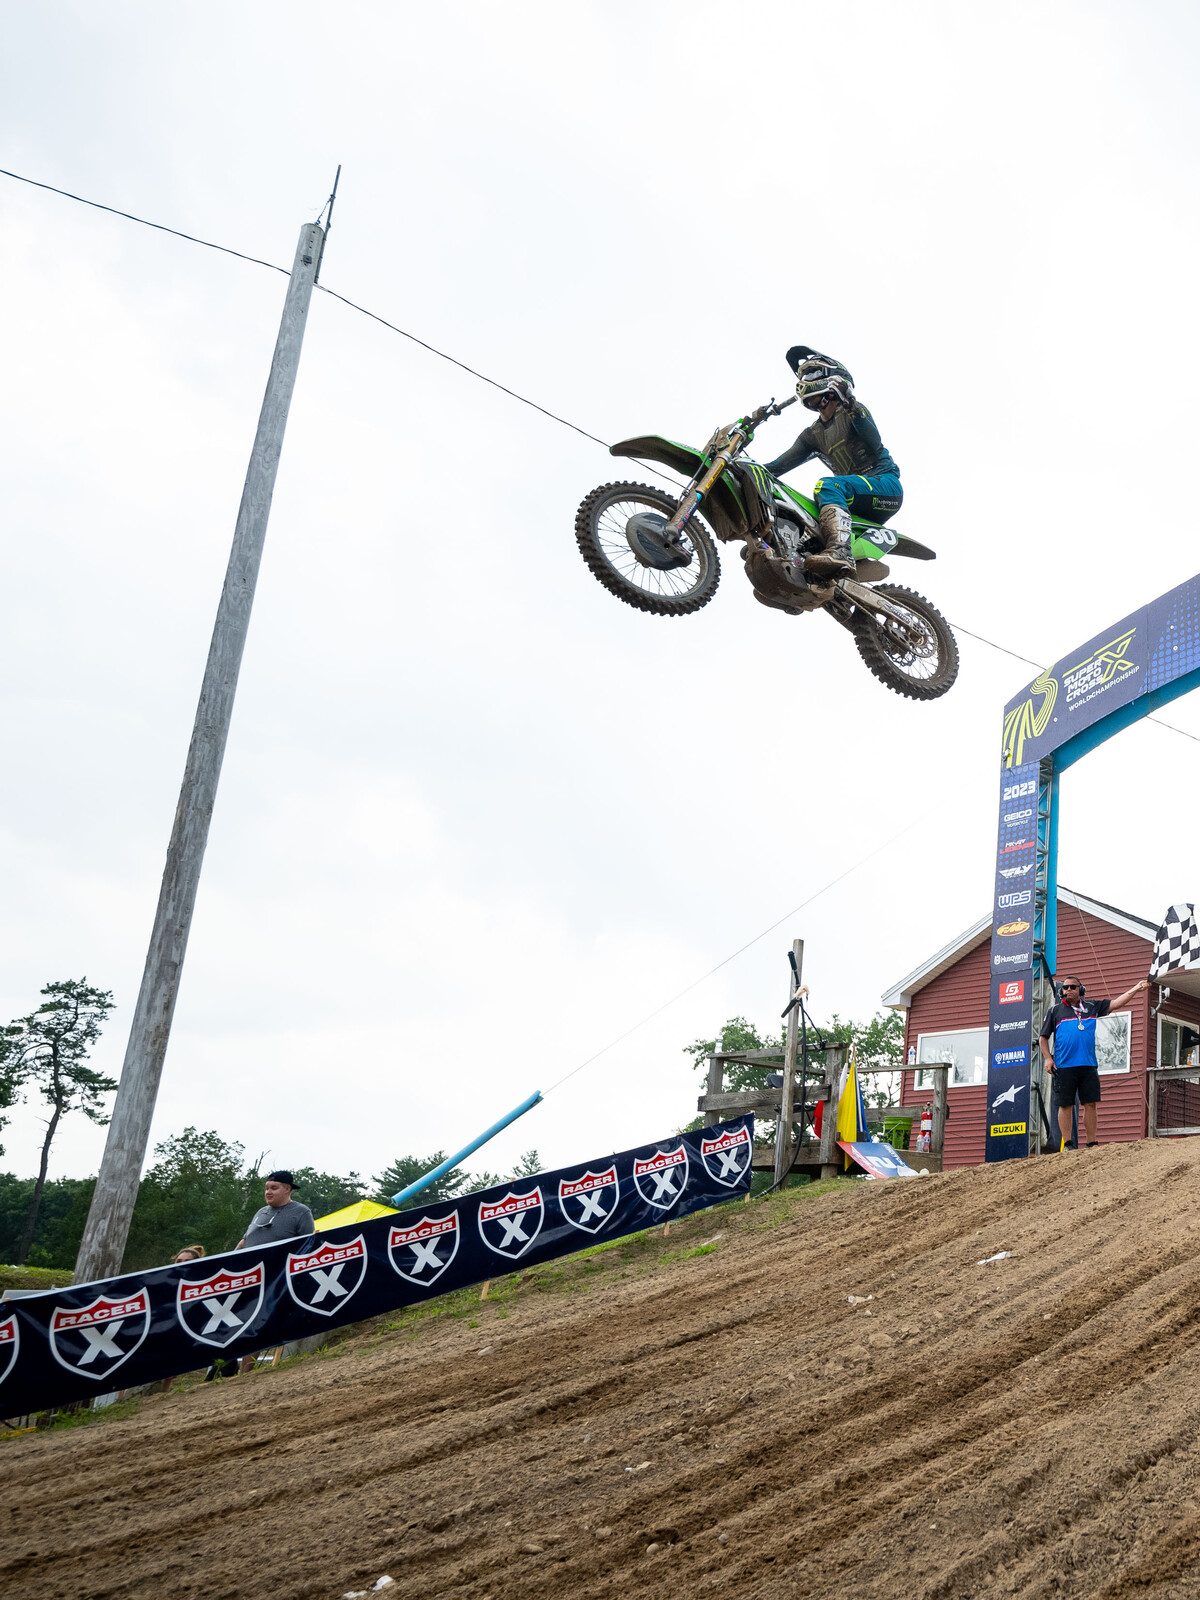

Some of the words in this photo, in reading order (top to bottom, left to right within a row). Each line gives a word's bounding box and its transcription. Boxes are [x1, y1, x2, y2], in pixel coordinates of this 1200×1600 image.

[866, 528, 897, 546] 30
[1064, 659, 1102, 688] SUPER
[1068, 667, 1101, 693] MOTO
[1066, 674, 1103, 702] CROSS
[1069, 695, 1091, 711] WORLD
[1091, 665, 1140, 698] CHAMPIONSHIP
[1003, 781, 1035, 800] 2023
[1004, 809, 1032, 822] GEICO
[999, 891, 1031, 908] WPS
[1000, 1020, 1028, 1029] DUNLOP
[1002, 1050, 1025, 1061] YAMAHA
[993, 1125, 1023, 1134] SUZUKI
[705, 1134, 745, 1153] RACER
[637, 1154, 684, 1173] RACER
[716, 1147, 743, 1179] X
[563, 1174, 614, 1194] RACER
[650, 1168, 678, 1200] X
[483, 1195, 538, 1218] RACER
[576, 1189, 608, 1223] X
[393, 1220, 455, 1244] RACER
[498, 1212, 530, 1248] X
[294, 1245, 360, 1271] RACER
[408, 1235, 444, 1275] X
[184, 1274, 258, 1299] RACER
[309, 1263, 348, 1304] X
[60, 1301, 141, 1327] RACER
[201, 1291, 244, 1335] X
[76, 1320, 125, 1366] X
